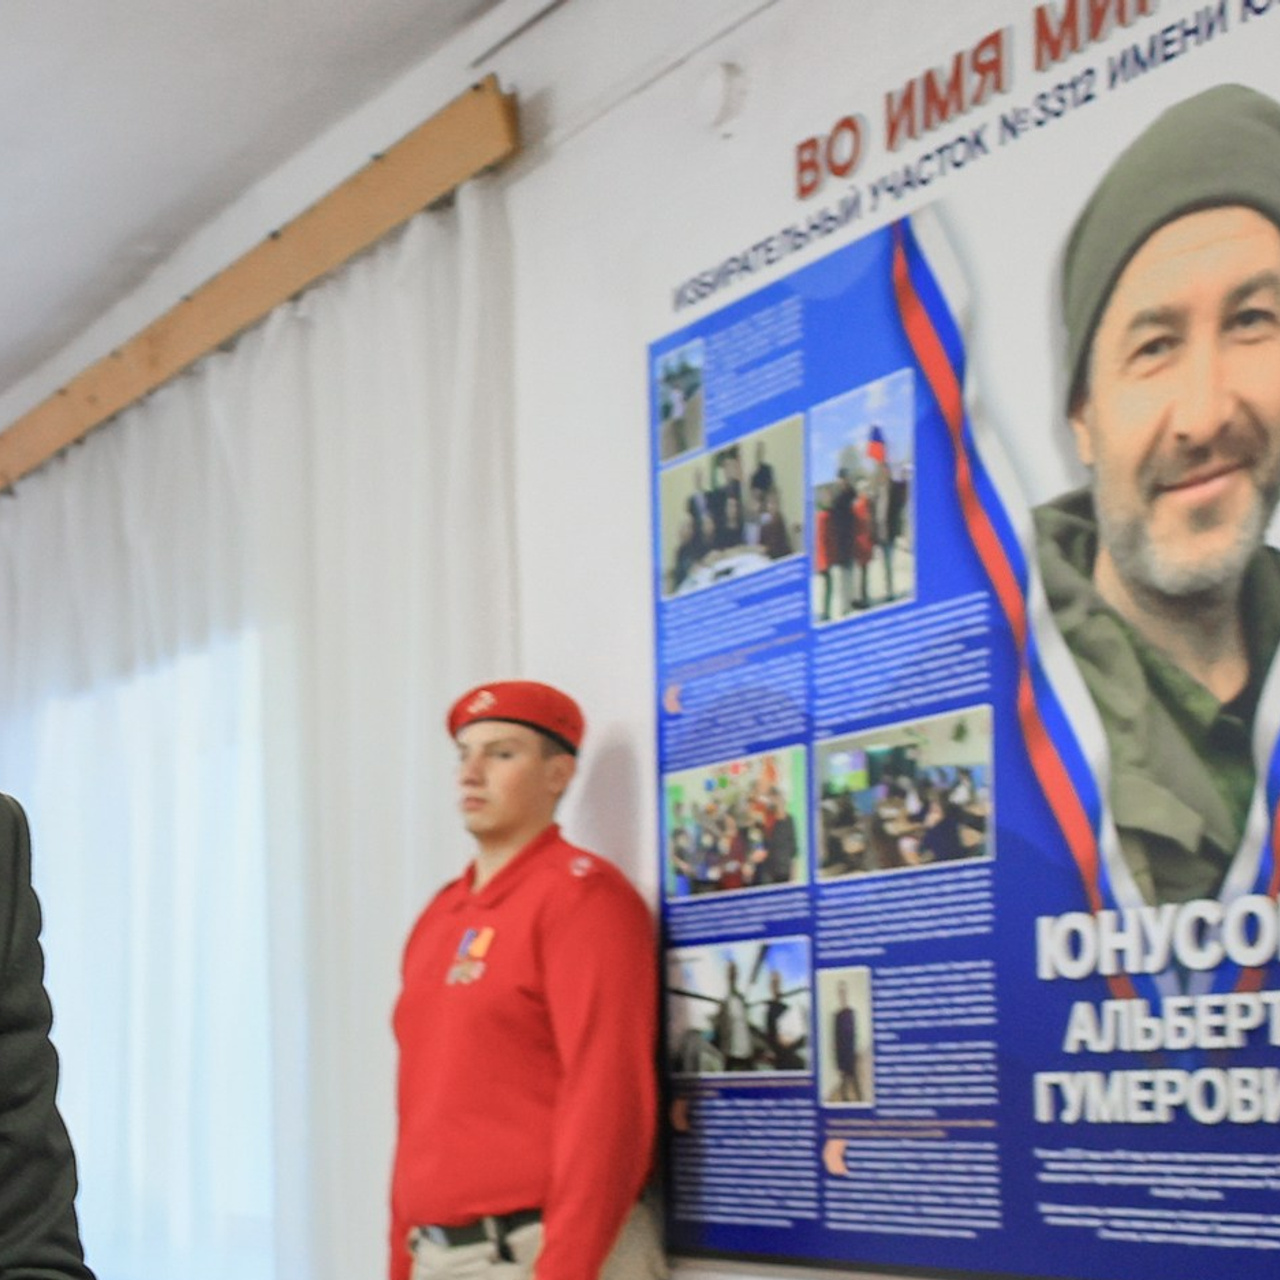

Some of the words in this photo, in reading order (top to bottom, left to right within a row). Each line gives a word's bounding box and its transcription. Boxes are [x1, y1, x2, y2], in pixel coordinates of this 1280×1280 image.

[796, 114, 862, 200] ВО
[885, 27, 1006, 151] ИМЯ
[1034, 0, 1150, 72] МИ
[869, 123, 990, 212] УЧАСТОК
[1107, 0, 1228, 90] ИМЕНИ
[1034, 893, 1280, 980] ЮНУСО
[1062, 990, 1280, 1054] АЛЬБЕРТ
